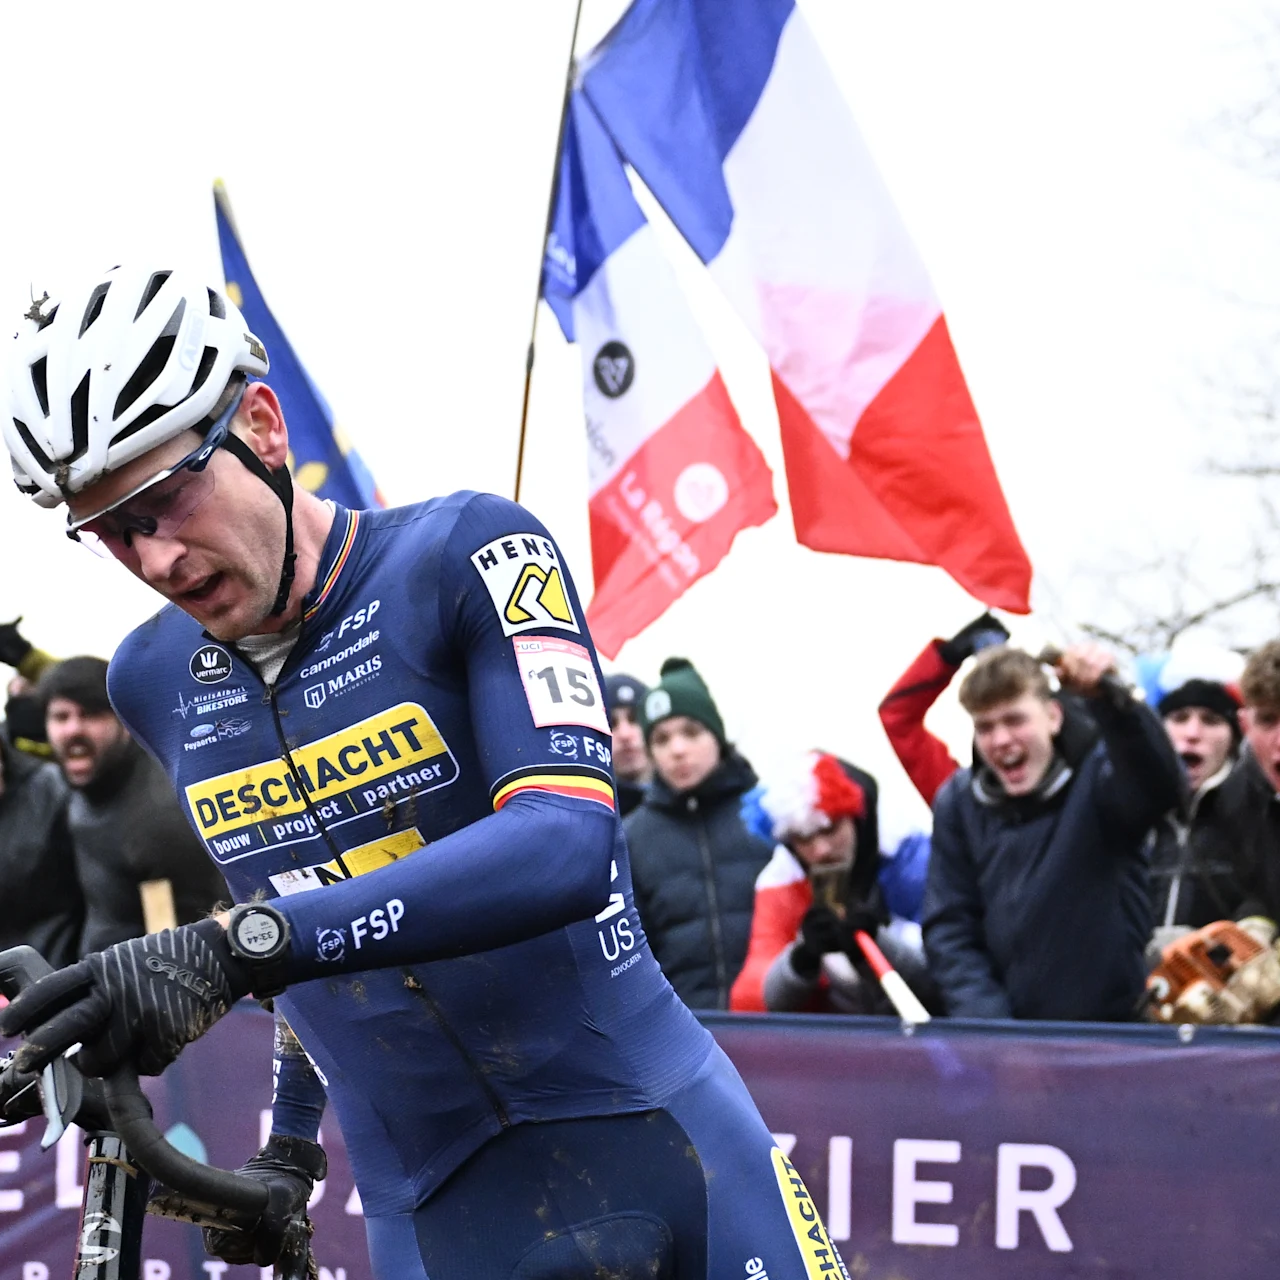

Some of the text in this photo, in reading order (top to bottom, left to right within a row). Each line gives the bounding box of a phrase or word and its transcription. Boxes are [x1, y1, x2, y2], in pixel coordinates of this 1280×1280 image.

[478, 538, 554, 571] HENS
[338, 600, 380, 639] FSP
[300, 630, 380, 679] cannondale
[521, 643, 540, 651] UCI
[196, 667, 228, 679] vermarc
[327, 654, 382, 695] MARIS
[537, 665, 595, 708] 15
[197, 693, 248, 715] BIKESTORE
[184, 735, 217, 751] Feyaerts
[555, 740, 573, 749] FSP
[583, 736, 612, 767] FSP
[195, 718, 423, 829] DESCHACHT
[213, 762, 443, 855] bouw project partner
[351, 898, 405, 950] FSP
[598, 917, 635, 961] US
[322, 938, 340, 953] FSP
[610, 952, 642, 978] ADVOCATEN
